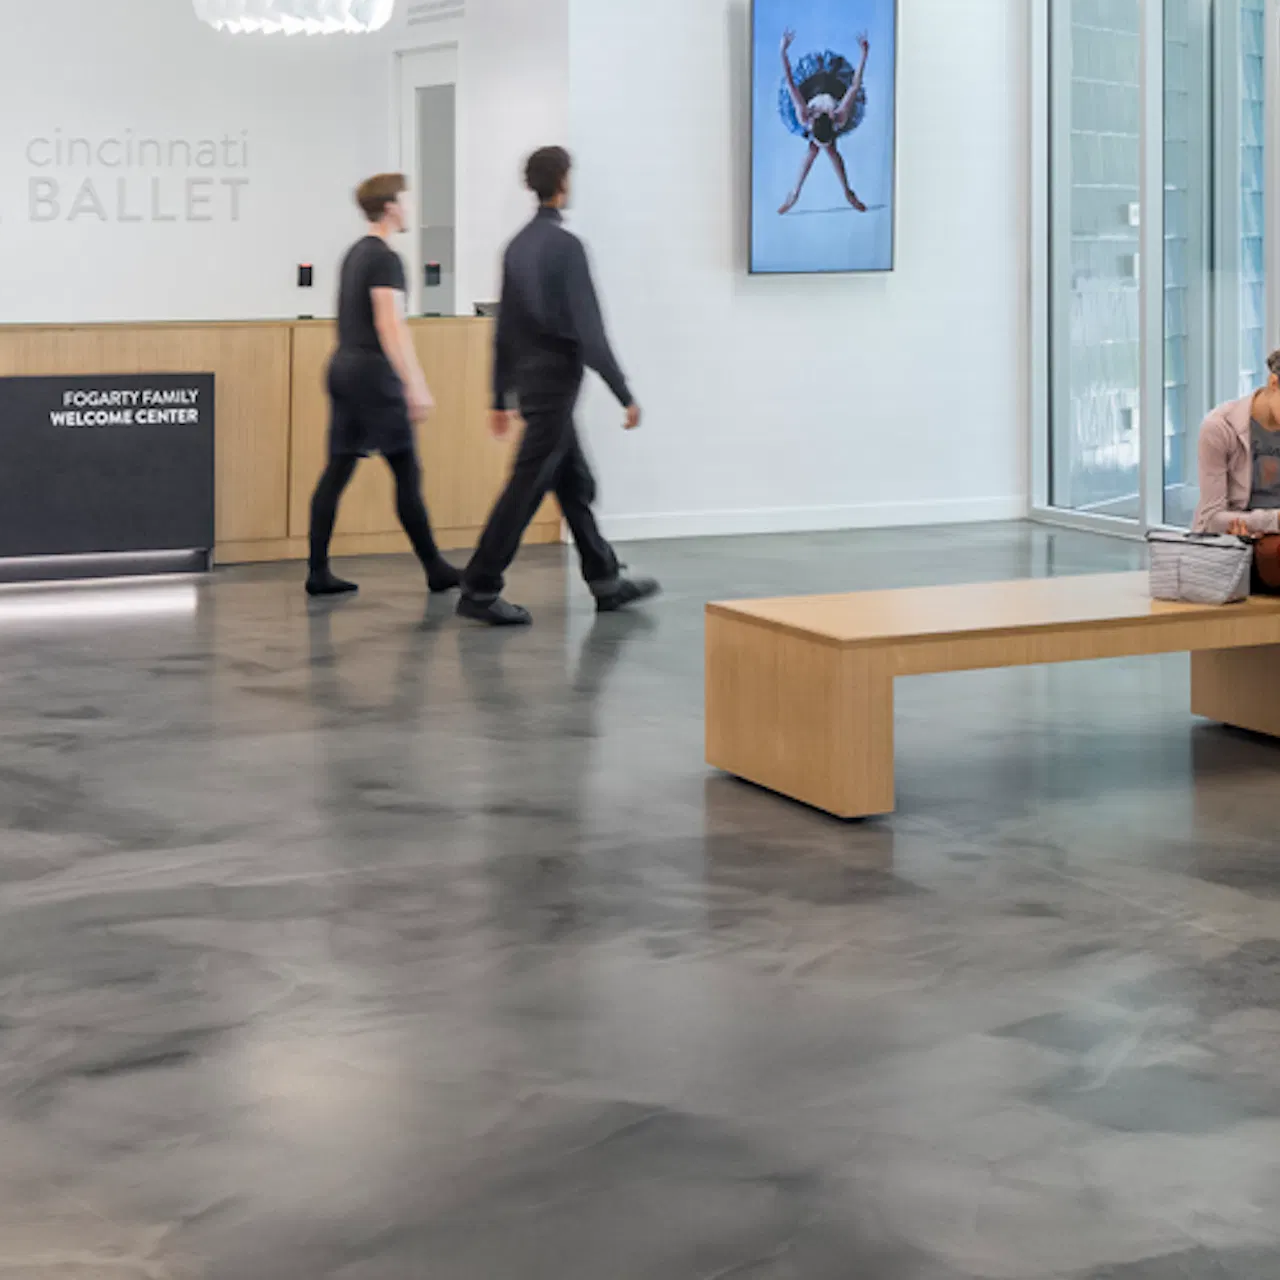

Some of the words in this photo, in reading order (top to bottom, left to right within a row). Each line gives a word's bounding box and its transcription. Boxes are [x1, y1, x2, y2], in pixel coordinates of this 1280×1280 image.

[26, 127, 250, 168] cincinnati
[28, 176, 250, 222] BALLET
[62, 390, 140, 406] FOGARTY
[142, 388, 199, 404] FAMILY
[49, 409, 133, 426] WELCOME
[134, 407, 199, 424] CENTER
